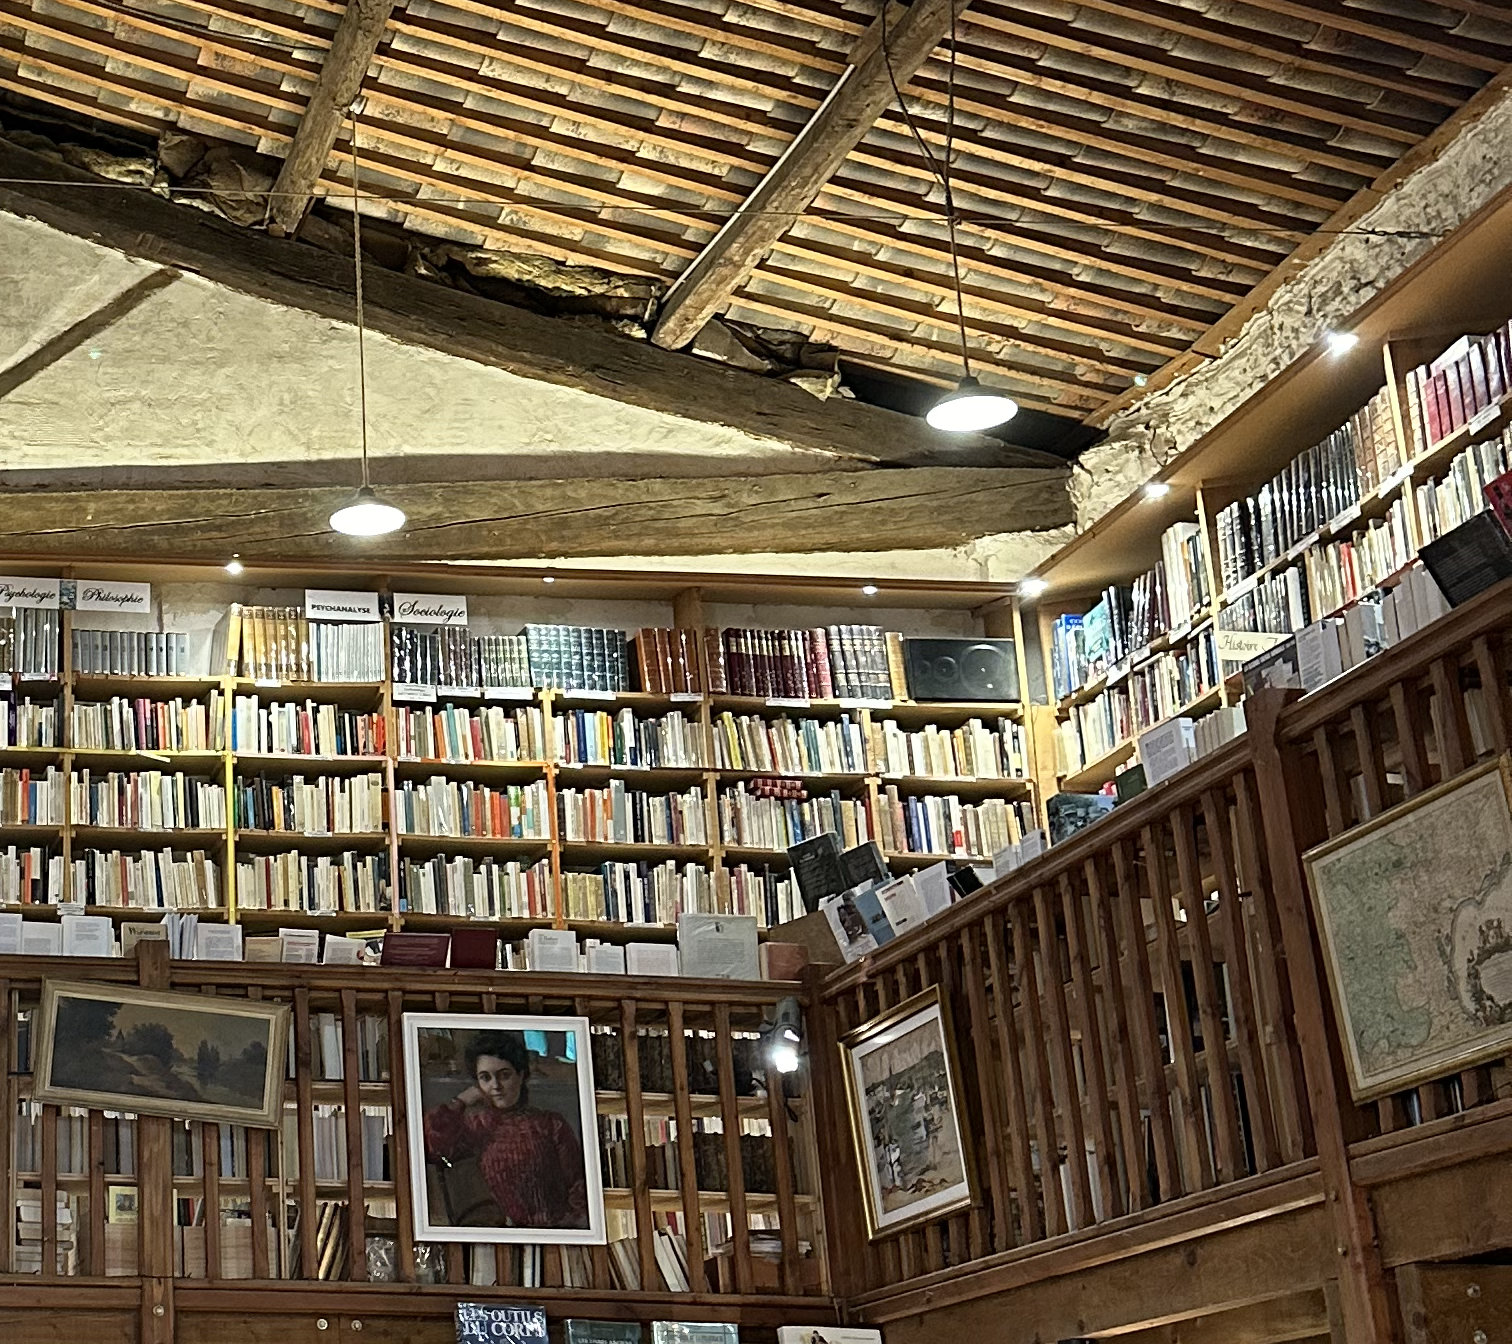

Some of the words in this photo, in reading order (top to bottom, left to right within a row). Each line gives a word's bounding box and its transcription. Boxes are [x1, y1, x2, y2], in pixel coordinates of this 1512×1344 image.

[82, 587, 144, 607] Philosophie
[311, 604, 371, 614] PSYCHANALYSE
[397, 600, 466, 623] Sociologie
[490, 1309, 544, 1322] OUTILS
